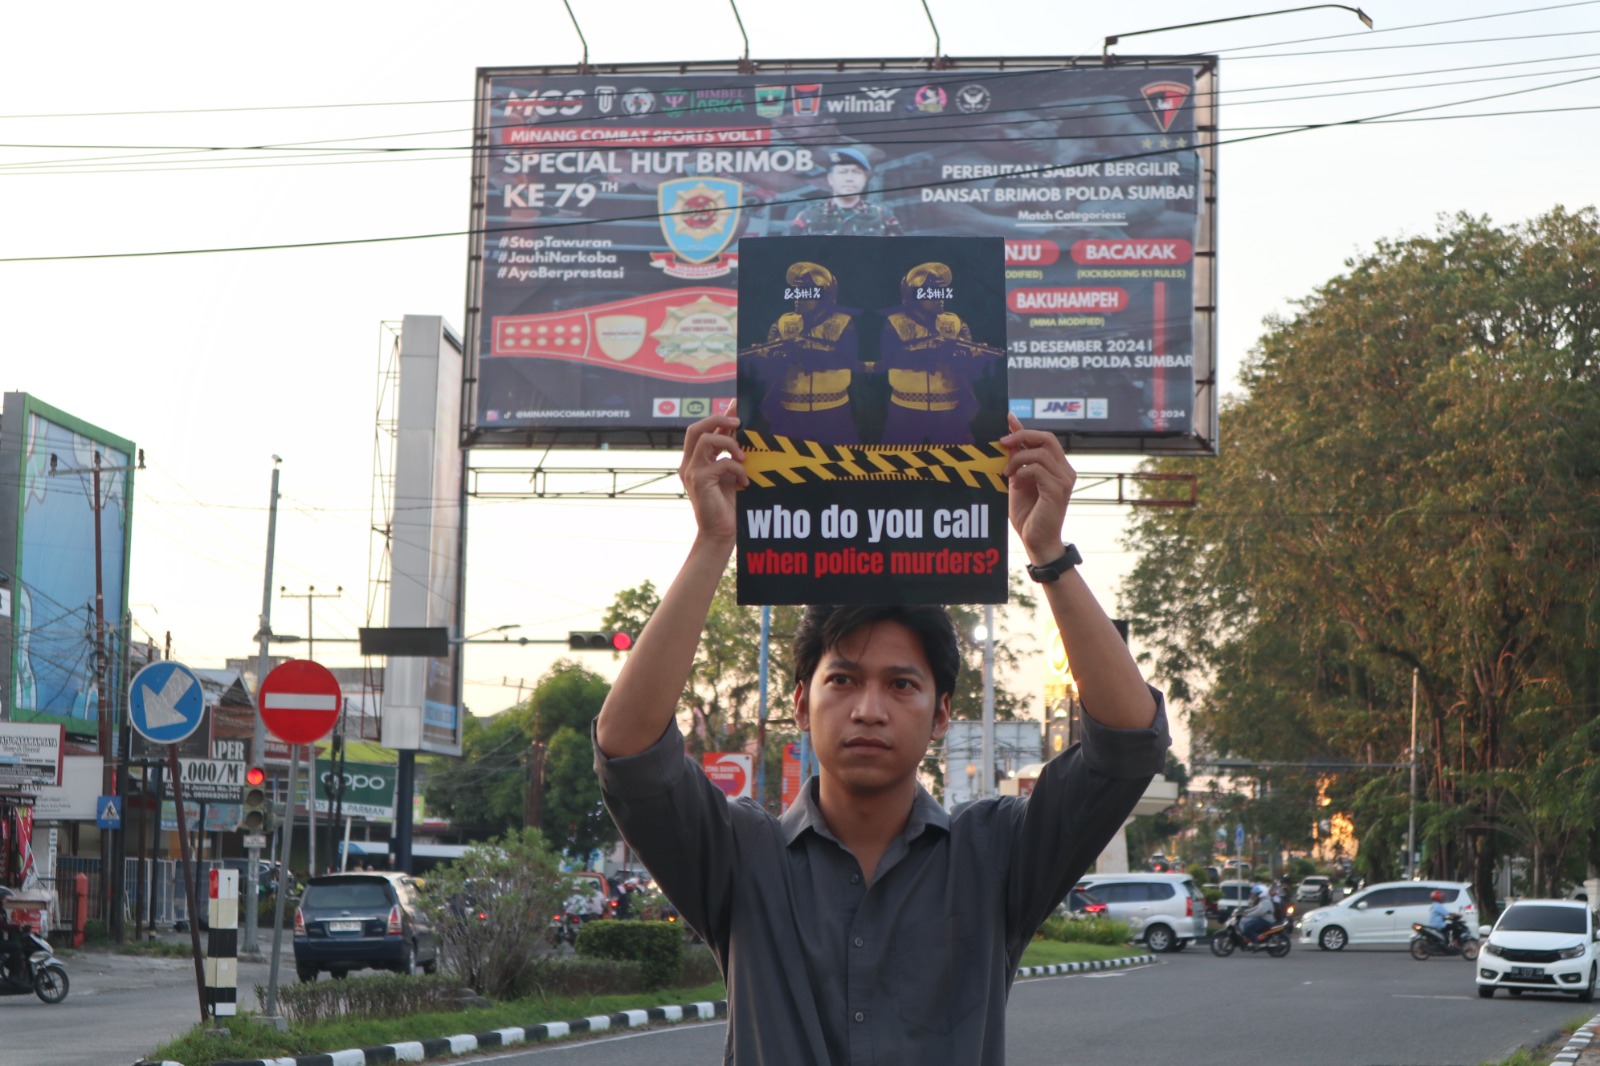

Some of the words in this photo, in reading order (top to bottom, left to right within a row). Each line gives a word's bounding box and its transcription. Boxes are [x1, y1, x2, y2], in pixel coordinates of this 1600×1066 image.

[696, 89, 745, 99] BIMBEL
[503, 89, 586, 116] MCS
[696, 99, 745, 113] ARKA
[827, 96, 895, 113] wilmar
[511, 130, 577, 143] MINANG
[580, 129, 649, 142] COMBAT
[652, 129, 714, 142] SPORTS
[717, 129, 762, 142] VOL.1
[503, 152, 622, 174] SPECIAL
[631, 151, 689, 174] HUT
[697, 150, 814, 174] BRIMOB
[1043, 163, 1100, 178] SABUK
[1104, 162, 1180, 177] BERGILIR
[504, 183, 545, 208] KE
[554, 183, 597, 208] 79
[921, 188, 991, 202] DANSAT
[994, 187, 1062, 202] BRIMOB
[1066, 186, 1124, 201] POLDA
[1017, 210, 1053, 221] Match
[499, 236, 612, 250] #StopTawuran
[498, 251, 617, 264] #JauhiNarkoba
[1086, 244, 1176, 260] BACAKAK
[497, 266, 624, 281] #AyoBerprestasi
[1016, 292, 1119, 309] BAKUHAMPEH
[1030, 340, 1103, 353] DESEMBER
[1106, 340, 1143, 352] 2024
[1008, 356, 1080, 369] ATBRIMOB
[1083, 355, 1131, 368] POLDA
[1134, 355, 1193, 368] SUMBAR
[1041, 401, 1082, 413] JNE
[515, 410, 631, 419] @MINANGCOMBATSPORTS
[747, 505, 811, 539] who
[820, 504, 858, 539] do
[868, 508, 923, 543] you
[933, 504, 989, 539] call
[747, 548, 808, 575] when
[814, 547, 884, 578] police
[891, 548, 999, 575] murders?
[347, 805, 385, 815] PARMAN
